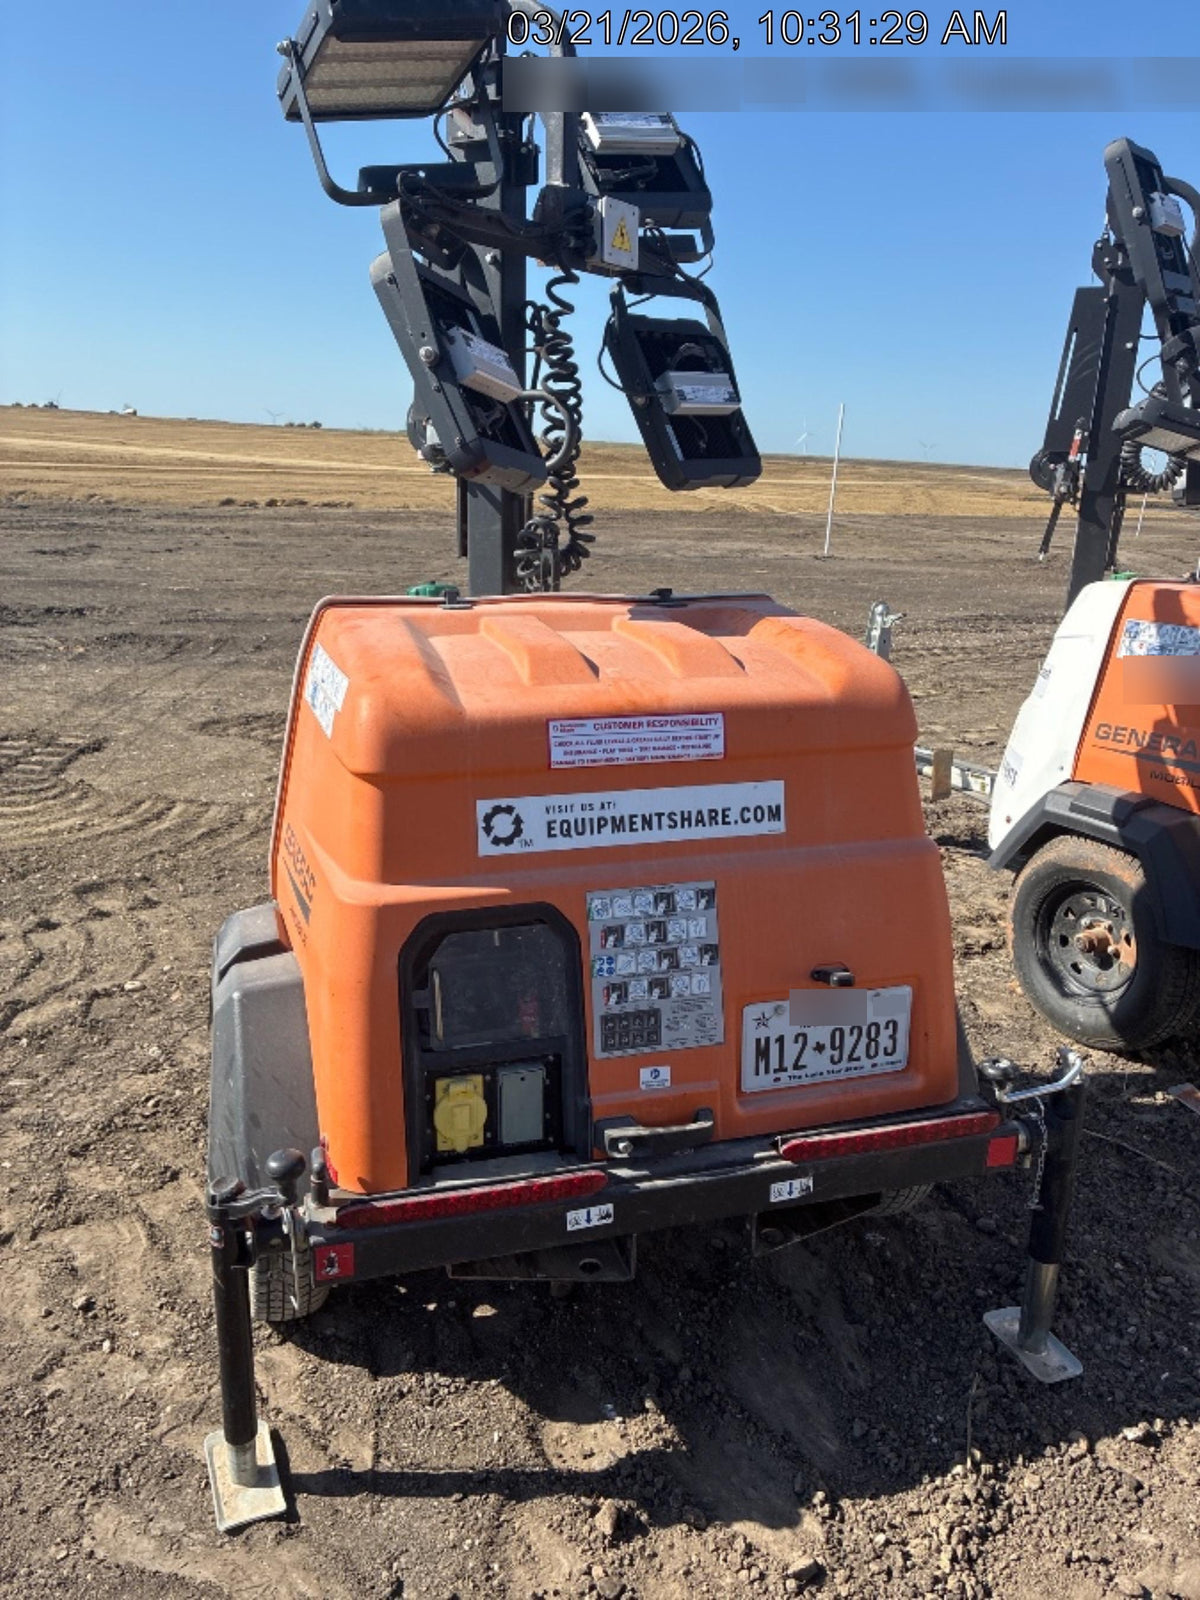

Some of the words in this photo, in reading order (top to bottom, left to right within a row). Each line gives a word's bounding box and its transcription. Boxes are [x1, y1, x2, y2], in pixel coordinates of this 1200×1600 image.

[593, 720, 645, 731] CUSTOMER
[647, 717, 719, 729] RESPONSIBILITY
[545, 803, 575, 815] VISIT
[581, 802, 595, 812] US
[547, 804, 782, 838] EQUIPMENTSHARE.COM
[754, 1032, 808, 1076] M12
[830, 1019, 899, 1065] 9283
